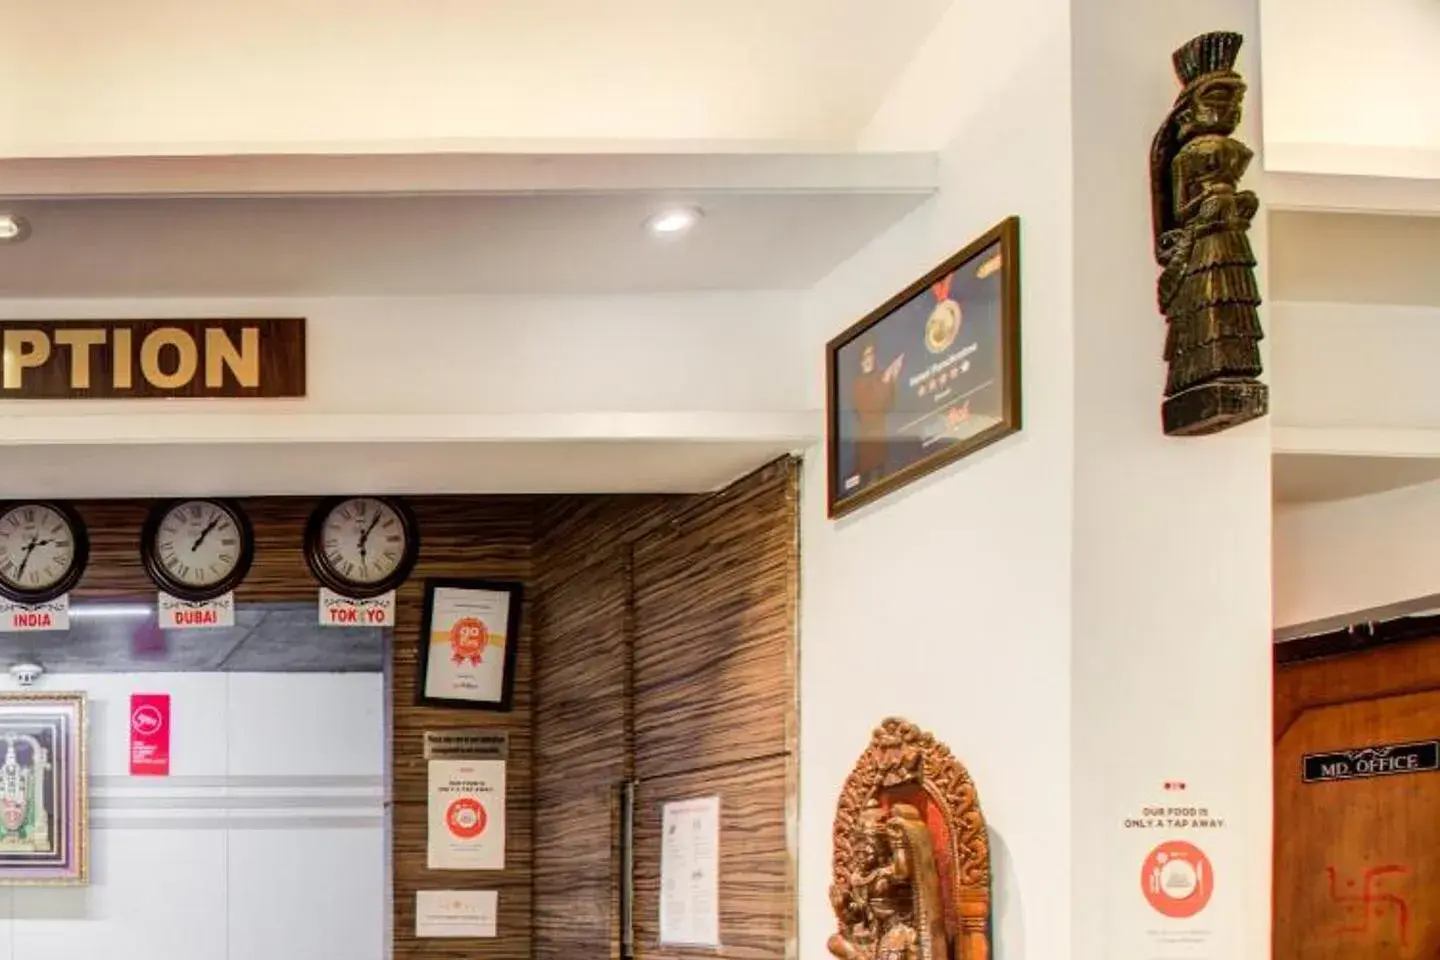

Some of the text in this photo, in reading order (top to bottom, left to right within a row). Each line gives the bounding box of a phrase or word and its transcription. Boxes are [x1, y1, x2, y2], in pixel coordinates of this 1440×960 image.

[14, 614, 51, 627] INDIA
[174, 611, 217, 625] DUBAI
[1356, 754, 1419, 773] OFFICE
[1143, 807, 1208, 817] OUR FOOD IS
[1124, 819, 1224, 829] ONLY A TAP AWAY
